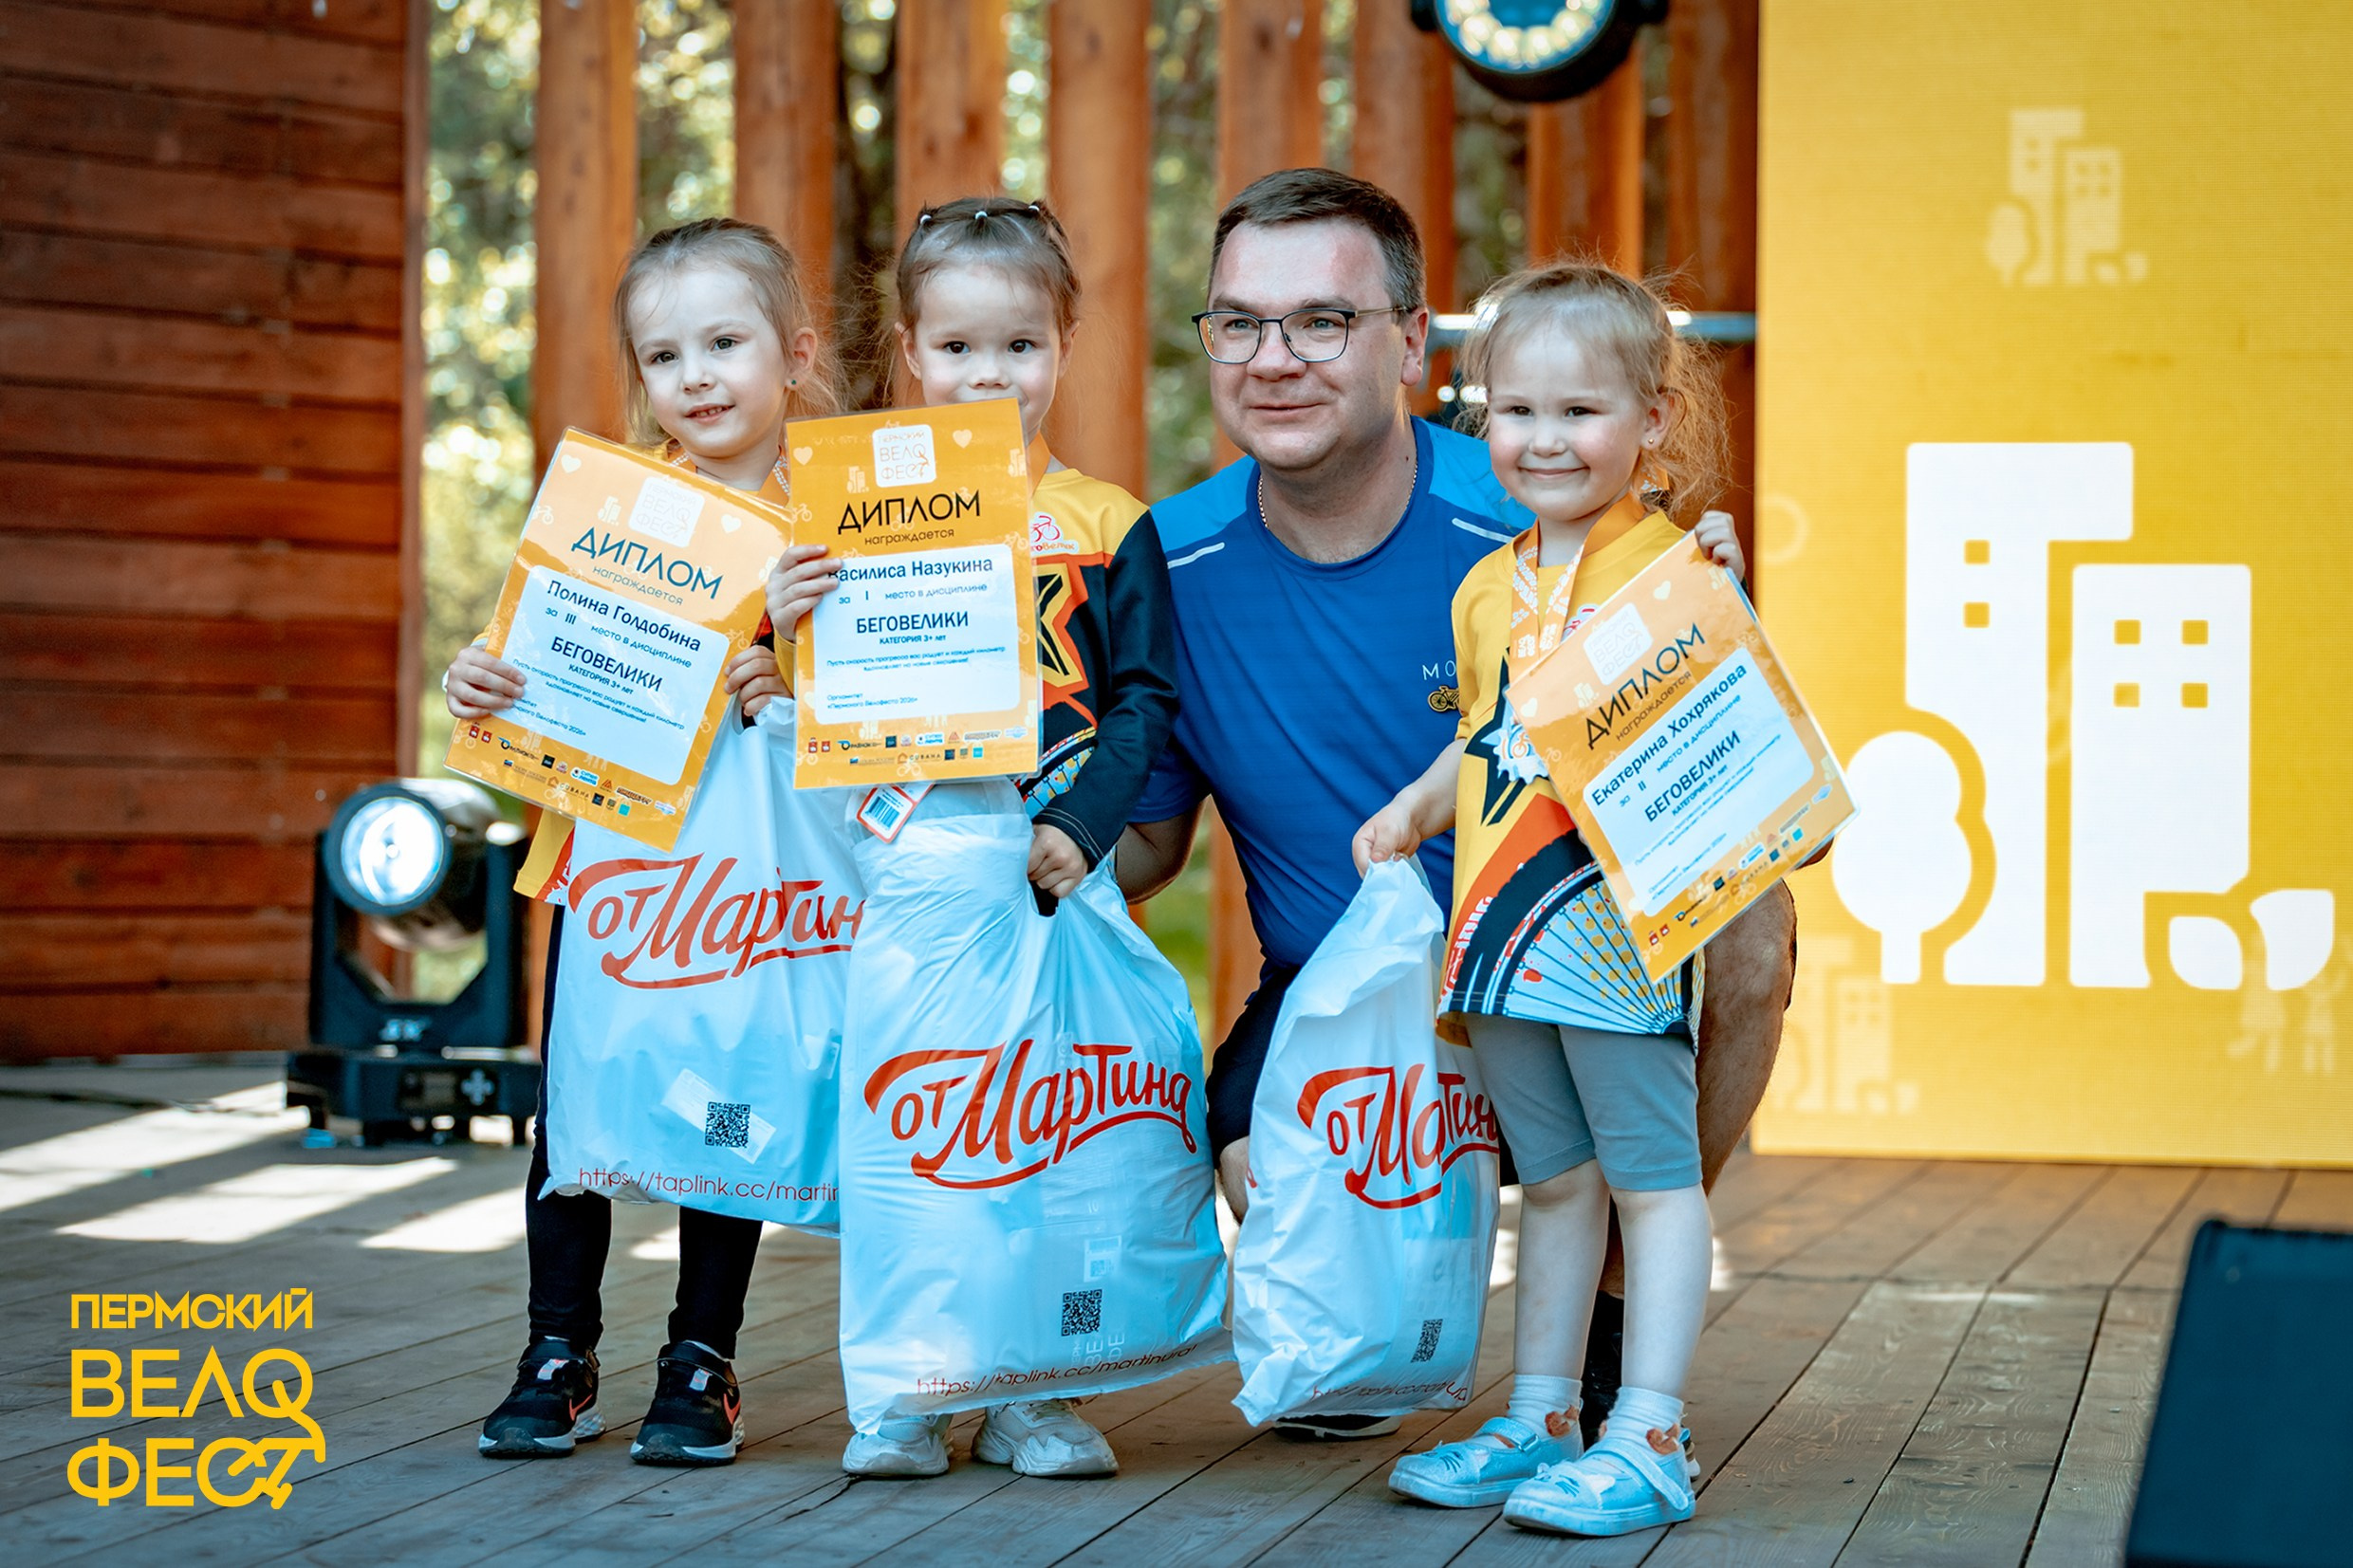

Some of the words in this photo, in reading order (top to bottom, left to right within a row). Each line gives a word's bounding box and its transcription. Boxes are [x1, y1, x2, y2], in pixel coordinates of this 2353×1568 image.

[879, 442, 927, 463] ВЕЛО
[880, 461, 929, 481] ФЕСТ
[837, 489, 980, 535] ДИПЛОМ
[864, 528, 954, 545] награждается
[570, 526, 722, 599] ДИПЛОМ
[592, 565, 683, 605] награждается
[911, 559, 992, 577] Назукина
[547, 580, 608, 616] Полина
[612, 605, 700, 651] Голдобина
[838, 596, 850, 604] за
[884, 590, 916, 600] место
[925, 583, 987, 598] дисциплине
[545, 607, 558, 617] за
[565, 613, 576, 624] III
[590, 625, 621, 641] место
[629, 640, 692, 668] дисциплине
[856, 611, 968, 633] БЕГОВЕЛИКИ
[879, 635, 921, 644] КАТЕГОРИЯ
[550, 636, 662, 692] БЕГОВЕЛИКИ
[568, 663, 610, 685] КАТЕГОРИЯ
[621, 686, 633, 694] лет
[1585, 623, 1704, 750] ДИПЛОМ
[1615, 671, 1691, 741] награждается
[1591, 735, 1668, 805] Екатерина
[1667, 665, 1746, 737] Хохрякова
[1619, 794, 1630, 806] за
[1638, 781, 1646, 790] II
[1656, 747, 1682, 772] место
[1691, 694, 1740, 744] дисциплине
[1644, 729, 1740, 821] БЕГОВЕЛИКИ
[1671, 781, 1708, 816] КАТЕГОРИЯ
[1707, 774, 1715, 784] 3+
[567, 852, 866, 989] Мартин
[863, 1039, 1197, 1190] Мартина
